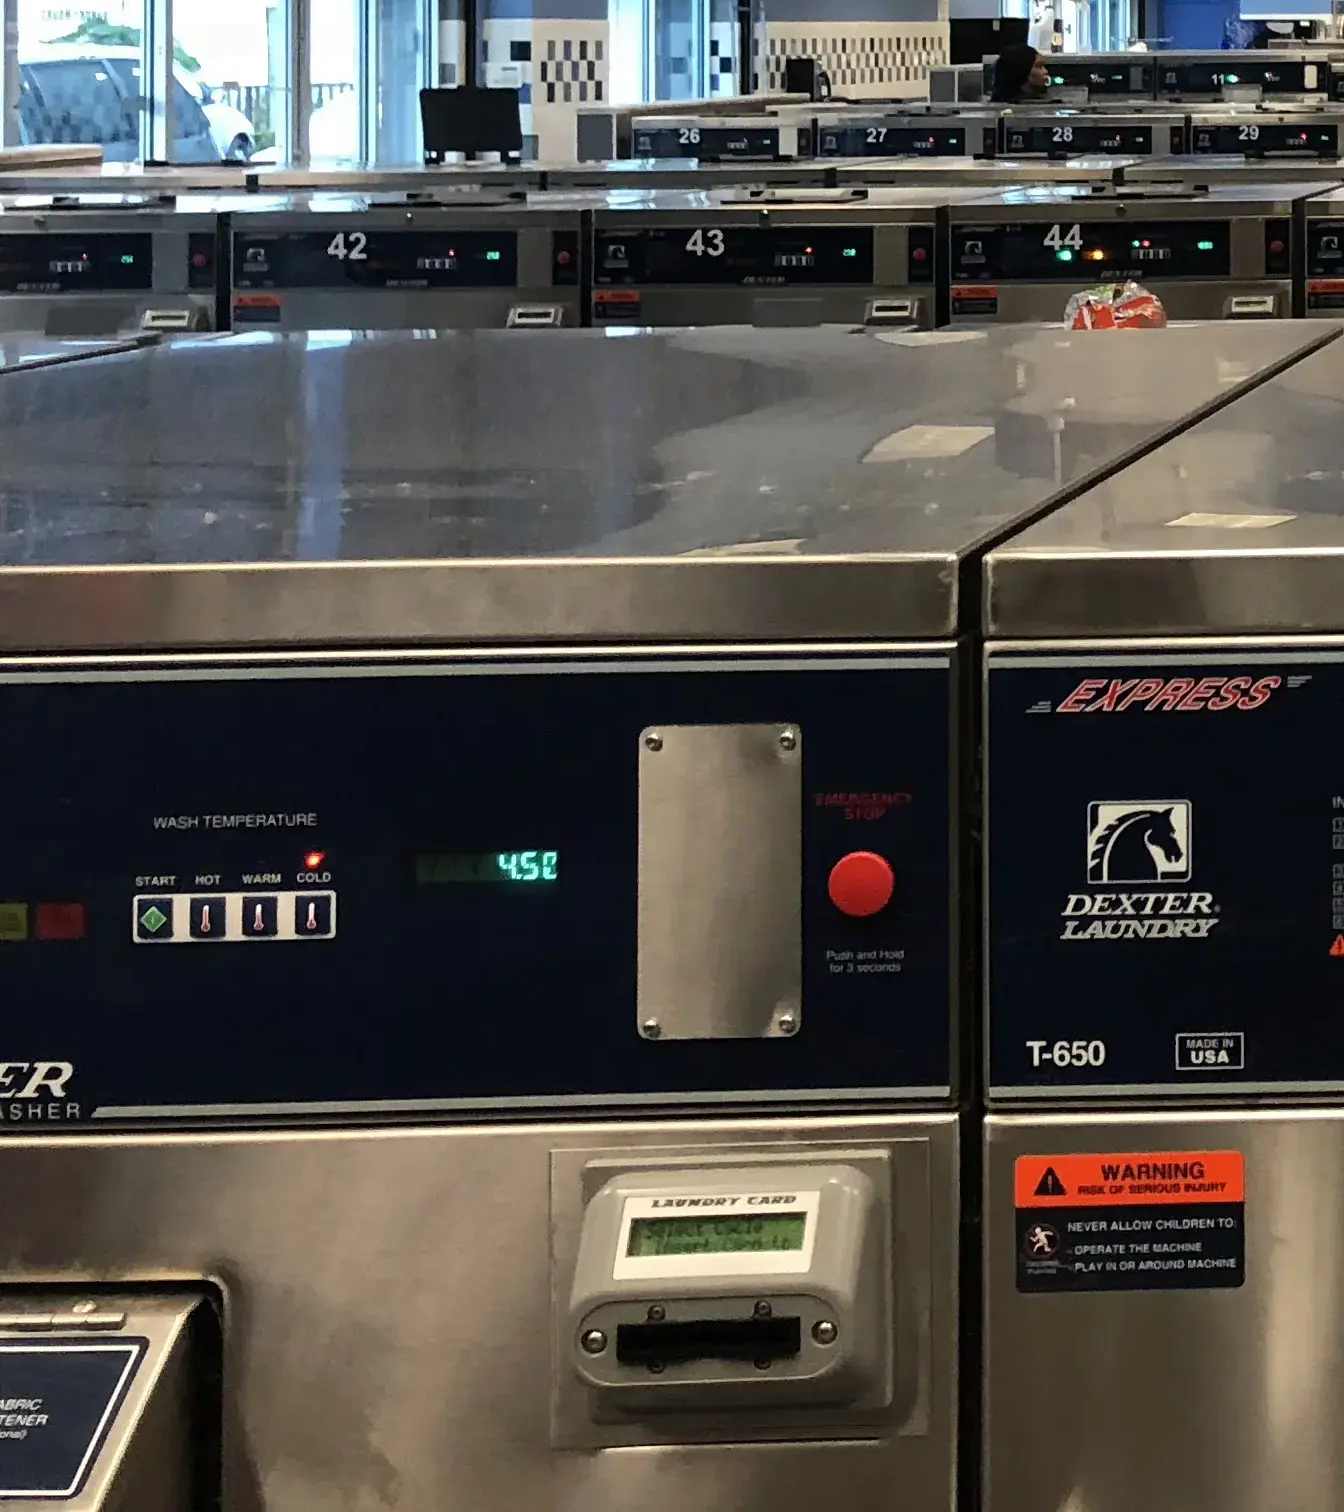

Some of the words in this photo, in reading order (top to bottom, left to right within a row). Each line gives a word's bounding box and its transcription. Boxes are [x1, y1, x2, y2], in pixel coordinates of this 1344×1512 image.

[678, 127, 701, 144] 26
[865, 127, 888, 144] 27
[1052, 126, 1074, 143] 28
[1238, 125, 1260, 141] 29
[685, 229, 725, 257] 43
[1043, 223, 1083, 251] 44
[326, 232, 368, 260] 42
[1056, 676, 1282, 713] EXPRESS
[153, 816, 199, 830] WASH
[202, 812, 318, 829] TEMPERATURE
[497, 850, 559, 881] 4.50
[135, 875, 177, 887] START
[194, 874, 222, 886] HOT
[241, 873, 282, 885] WARM
[296, 871, 332, 884] COLD
[1061, 891, 1216, 918] DEXTER
[1059, 918, 1220, 941] LAUNDRY
[826, 949, 853, 962] Push
[856, 949, 877, 960] and
[879, 948, 905, 960] Hold
[829, 962, 844, 974] for
[856, 962, 901, 974] seconds
[1186, 1038, 1219, 1049] MADE
[1222, 1037, 1235, 1048] IN
[1025, 1040, 1106, 1067] T-650
[1190, 1049, 1230, 1064] USA
[1100, 1161, 1205, 1181] WARNING
[1077, 1185, 1105, 1196] RISK
[1108, 1184, 1125, 1195] OF
[1128, 1183, 1182, 1195] SERIOUS
[1183, 1181, 1228, 1193] INJURY
[650, 1196, 742, 1209] LAUNDRY
[747, 1194, 797, 1206] CARD
[1067, 1220, 1108, 1233] NEVER
[1110, 1219, 1153, 1232] ALLOW
[1155, 1218, 1215, 1231] CHILDREN
[1217, 1217, 1237, 1230] TO:
[1074, 1244, 1126, 1256] OPERATE
[1129, 1243, 1150, 1254] THE
[1152, 1242, 1203, 1254] MACHINE
[1074, 1261, 1104, 1273] PLAY
[1105, 1261, 1117, 1272] IN
[1119, 1261, 1136, 1272] OR
[1138, 1259, 1186, 1271] AROUND
[1187, 1258, 1237, 1270] MACHINE
